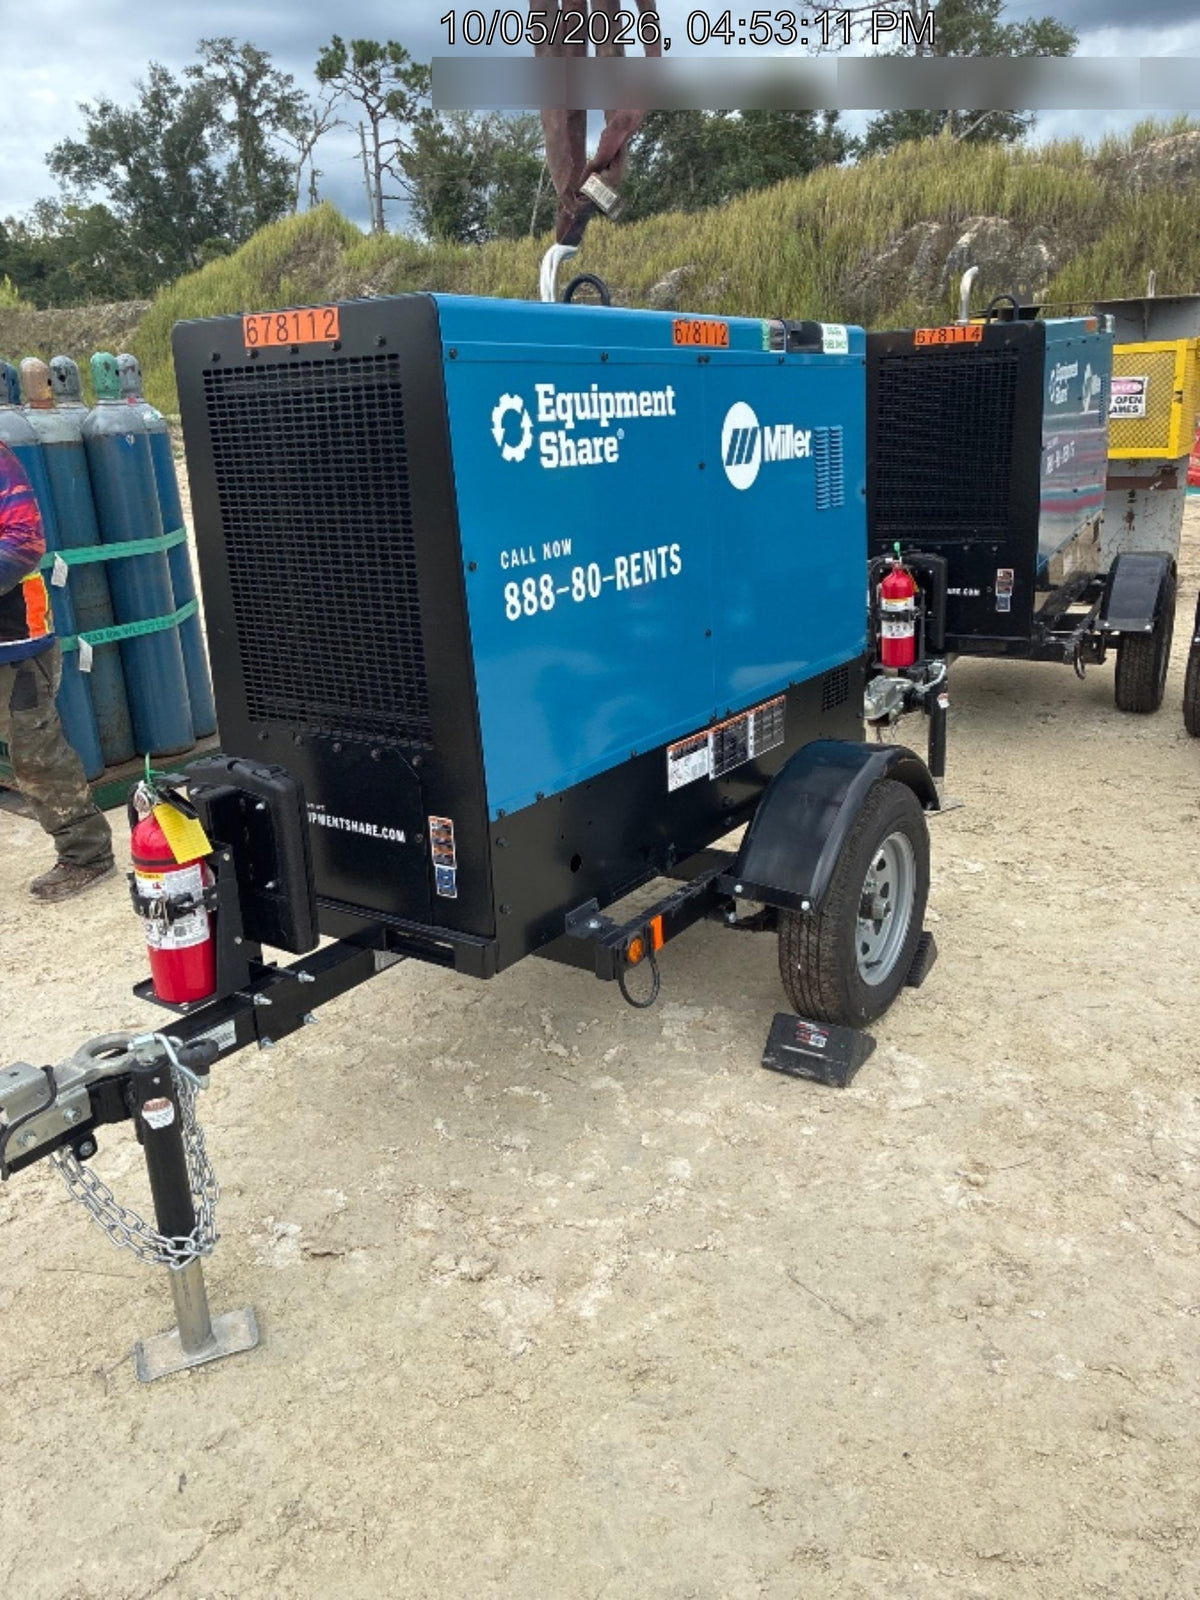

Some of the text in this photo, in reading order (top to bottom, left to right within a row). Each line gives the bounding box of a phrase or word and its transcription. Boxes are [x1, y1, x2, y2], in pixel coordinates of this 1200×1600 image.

[246, 309, 337, 345] 678112
[674, 319, 728, 346] 678112
[917, 326, 980, 344] 678114
[534, 383, 676, 429] Equipment
[1108, 405, 1138, 414] AMES
[1115, 396, 1142, 404] OPEN
[539, 430, 619, 468] Share
[763, 423, 811, 462] Miller
[500, 538, 572, 570] CALL NOW
[504, 543, 682, 621] 888-80-RENTS
